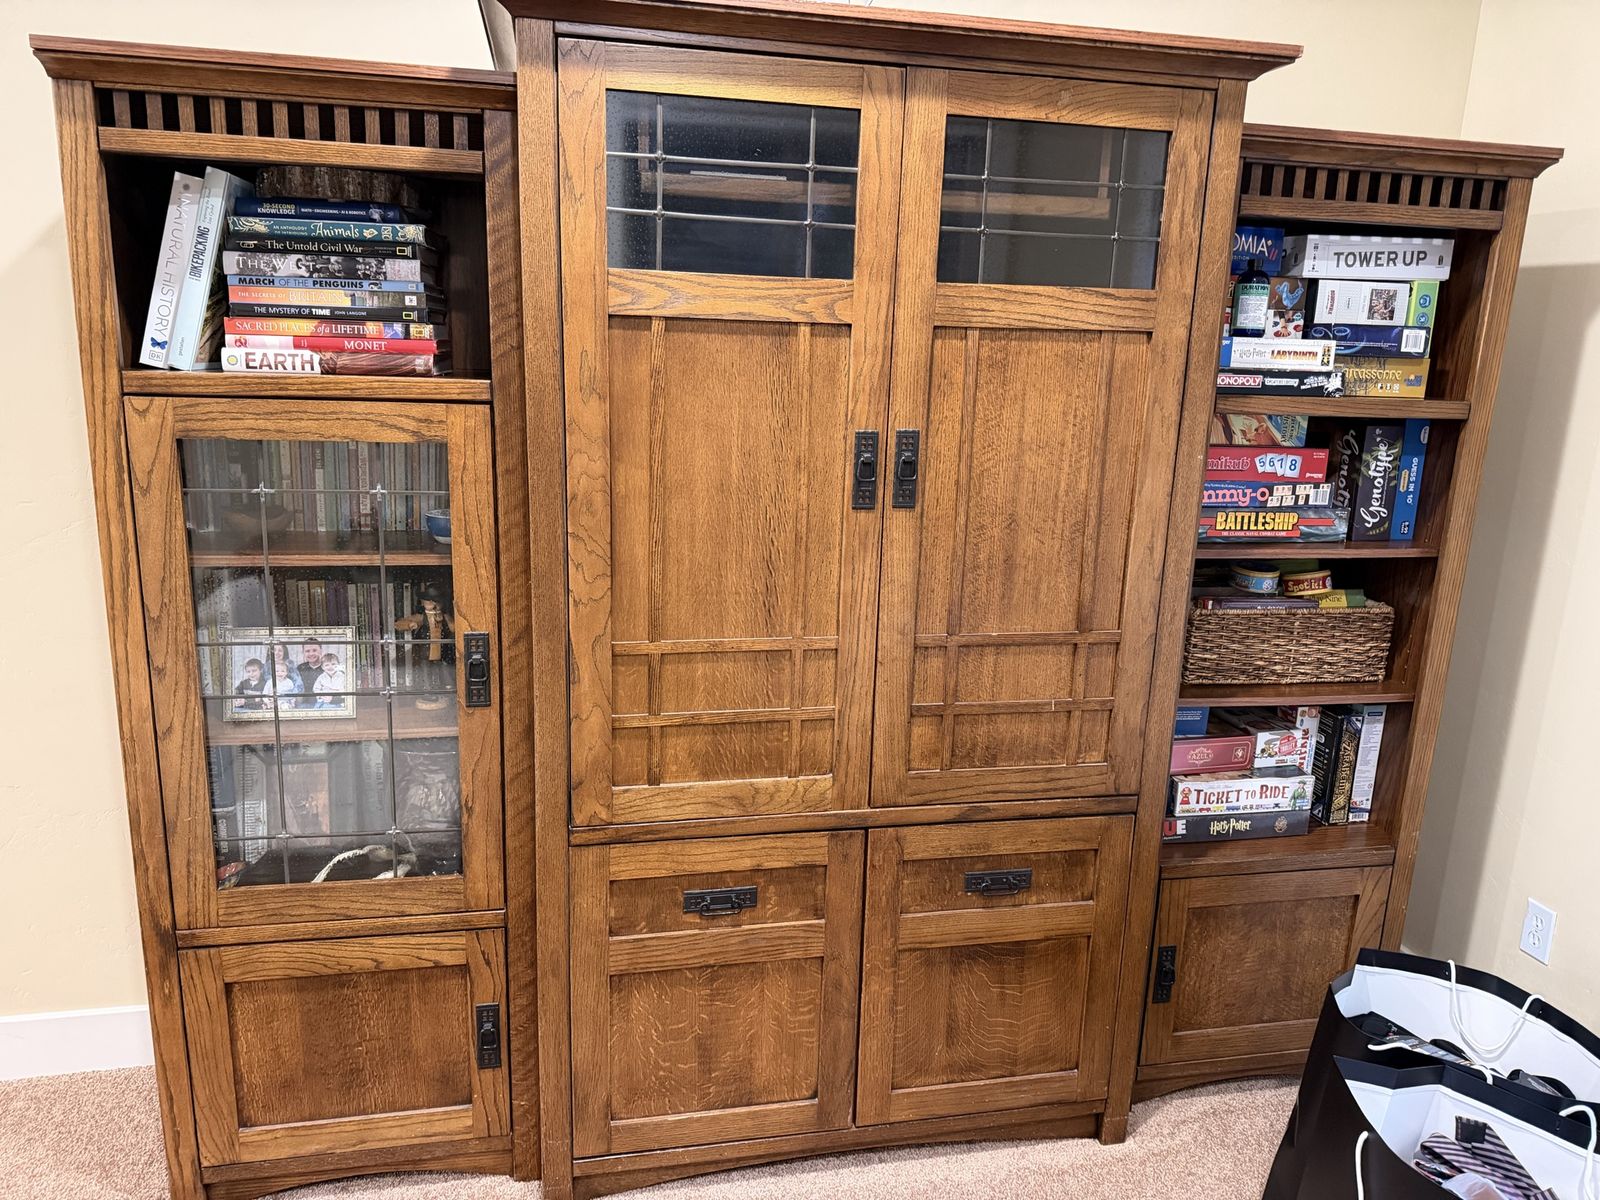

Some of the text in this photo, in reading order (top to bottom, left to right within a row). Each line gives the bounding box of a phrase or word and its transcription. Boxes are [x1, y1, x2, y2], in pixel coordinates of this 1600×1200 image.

[311, 222, 360, 239] Animals
[190, 225, 210, 279] BIKEPACKING
[265, 240, 284, 250] The
[286, 241, 318, 251] Untold
[320, 243, 342, 252] Civil
[344, 244, 364, 254] War
[154, 193, 192, 338] NATURAL HISTORY
[235, 256, 316, 271] THE WEST
[1333, 250, 1428, 268] TOWER UP
[238, 277, 364, 289] MARCH OF THE PENGUINS
[289, 291, 343, 303] BRITAIN
[253, 306, 267, 314] THE
[311, 308, 331, 316] TIME
[235, 321, 278, 331] SACRED
[280, 321, 316, 332] PLACES
[317, 323, 325, 335] of
[332, 324, 380, 335] LIFETIME
[344, 340, 388, 351] MONET
[244, 352, 315, 371] EARTH
[1271, 349, 1318, 361] LABYRINTH
[1258, 457, 1297, 471] 5 6 7 8
[1360, 440, 1399, 528] Genotype
[1406, 457, 1418, 504] GUESS IN 10
[1215, 511, 1299, 531] BATTLESHIP
[1288, 580, 1309, 593] Spot
[1259, 784, 1290, 800] RIDE
[1209, 818, 1252, 838] Harry Potter
